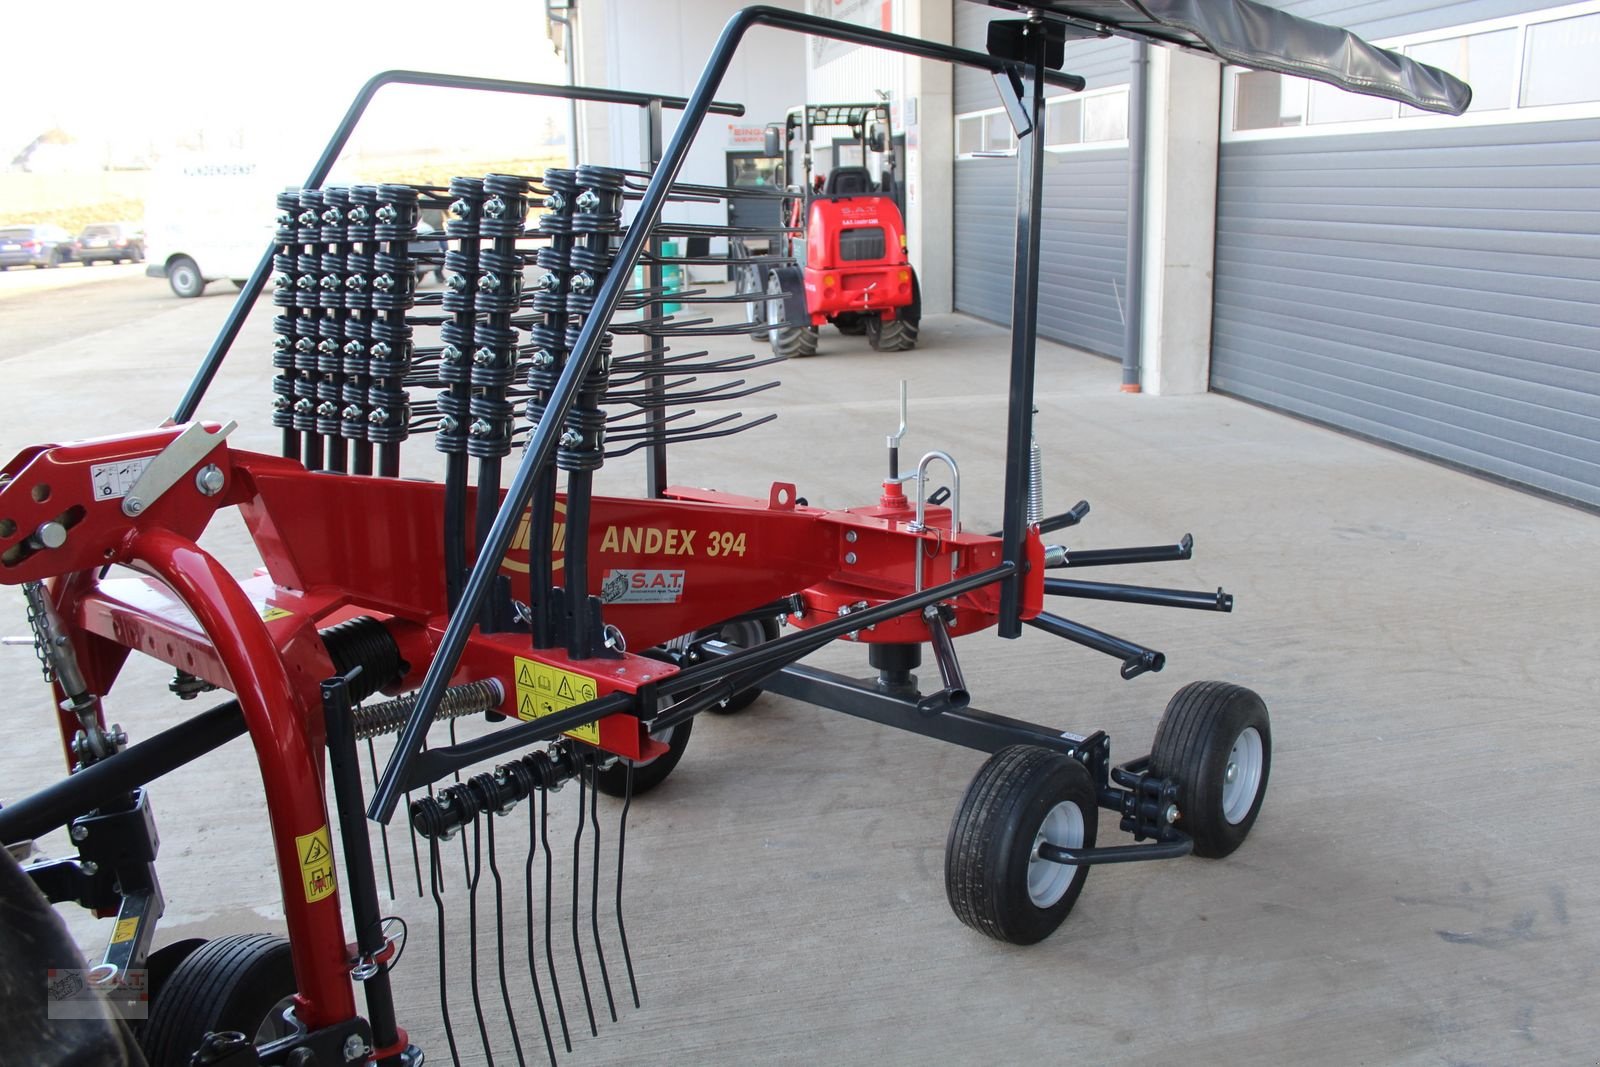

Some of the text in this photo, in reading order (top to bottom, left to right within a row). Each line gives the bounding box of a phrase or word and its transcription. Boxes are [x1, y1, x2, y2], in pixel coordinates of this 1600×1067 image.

[600, 525, 697, 556] ANDEX
[706, 530, 747, 557] 394
[631, 572, 683, 588] S.A.T.
